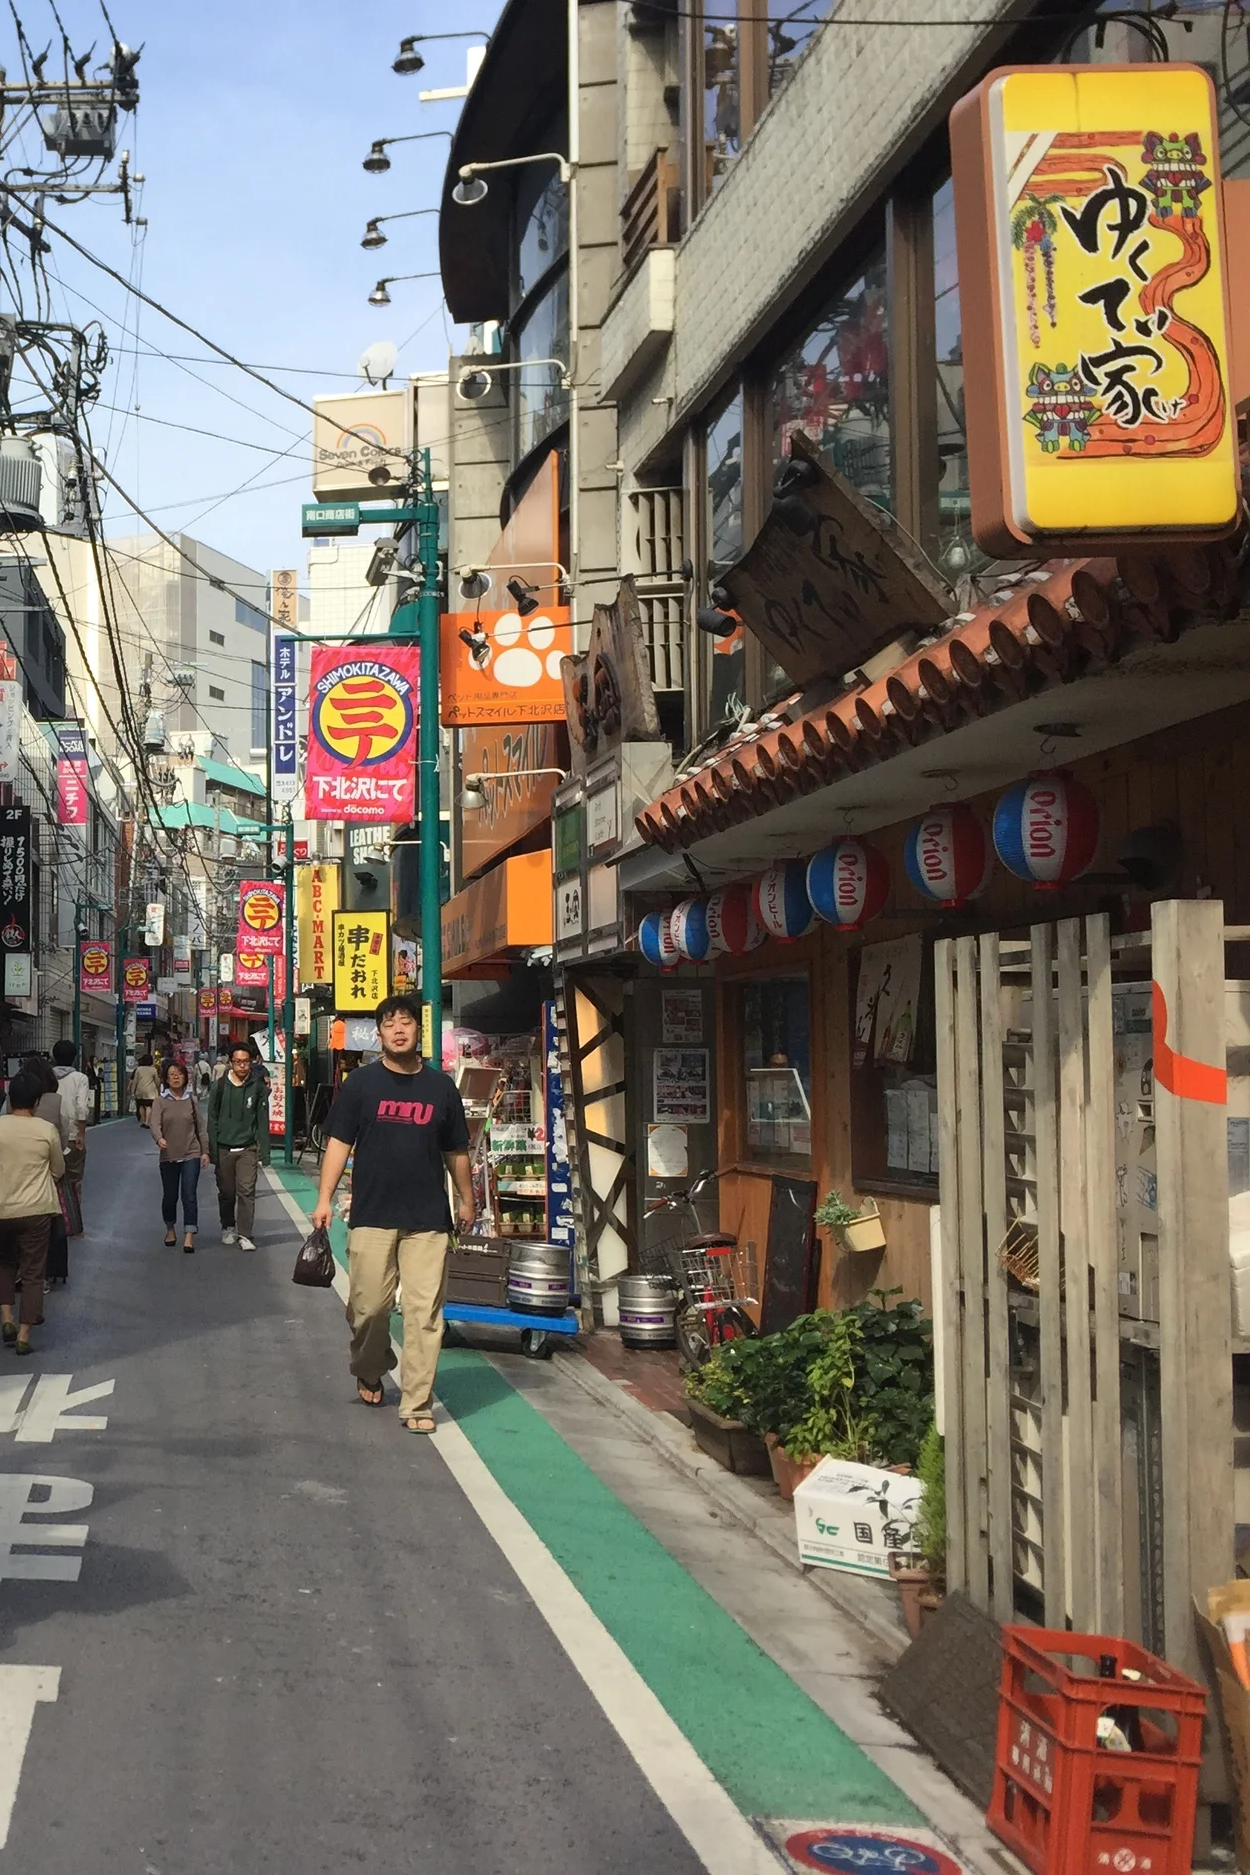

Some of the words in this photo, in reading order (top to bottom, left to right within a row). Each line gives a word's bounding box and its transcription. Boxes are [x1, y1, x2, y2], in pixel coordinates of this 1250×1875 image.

[318, 449, 357, 461] Seven
[279, 647, 291, 680] ホテル
[316, 662, 410, 696] SHIMOKITAZAWA
[312, 775, 408, 802] 下北沢にて
[5, 809, 23, 820] 2F
[343, 805, 385, 815] docomo
[349, 825, 391, 848] LEATHE
[311, 869, 325, 980] ABC-MART
[241, 935, 281, 947] 下北沢にて
[347, 923, 371, 999] 串だおれ
[370, 969, 379, 1000] 下北沢店
